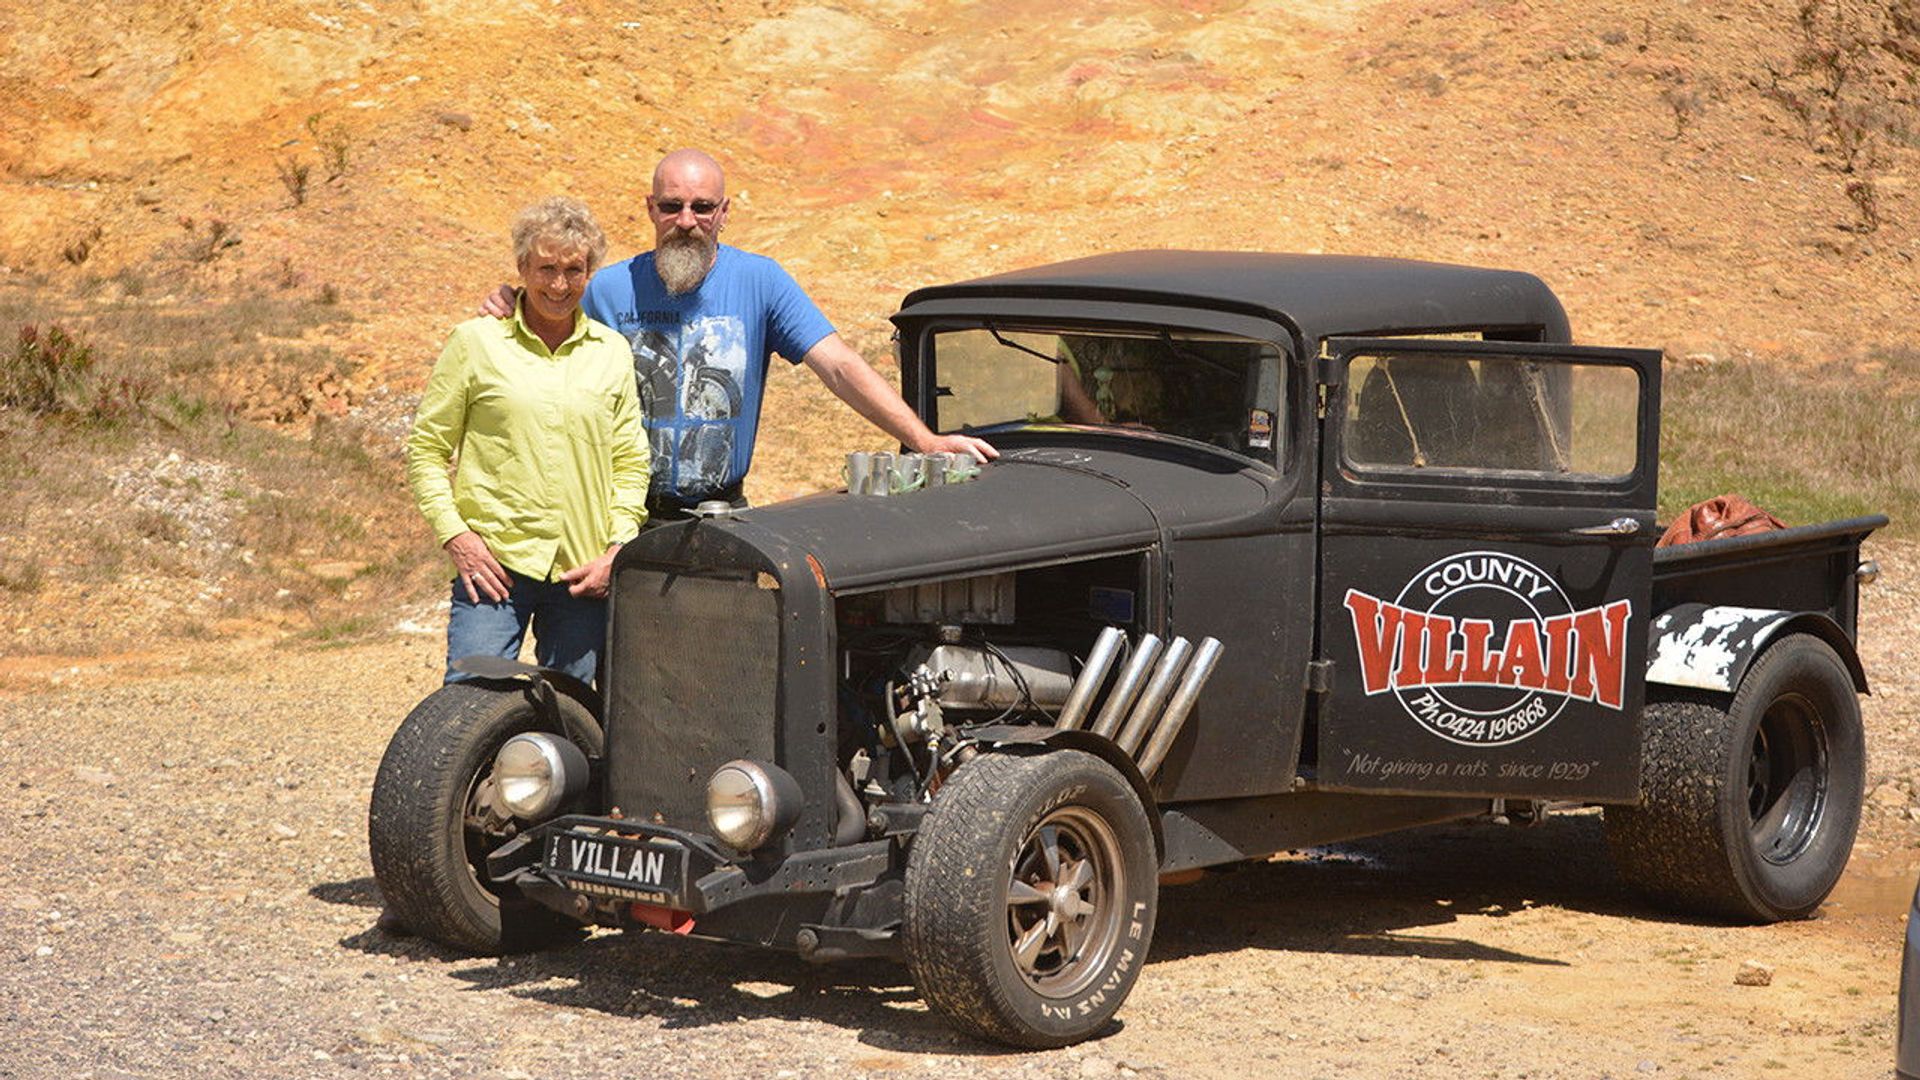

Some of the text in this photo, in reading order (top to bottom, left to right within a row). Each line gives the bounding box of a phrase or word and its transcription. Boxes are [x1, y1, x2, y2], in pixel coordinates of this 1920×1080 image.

[616, 310, 681, 326] CALIFORNIA
[1424, 558, 1552, 599] COUNTY
[1344, 588, 1632, 710] VILLAIN
[1487, 696, 1547, 741] 196868
[1379, 758, 1434, 781] giving
[1435, 762, 1448, 776] a
[1497, 761, 1544, 778] since
[549, 835, 561, 868] TAS
[571, 838, 665, 886] VILLAN
[1128, 902, 1147, 940] LE
[1076, 948, 1134, 1016] MANS
